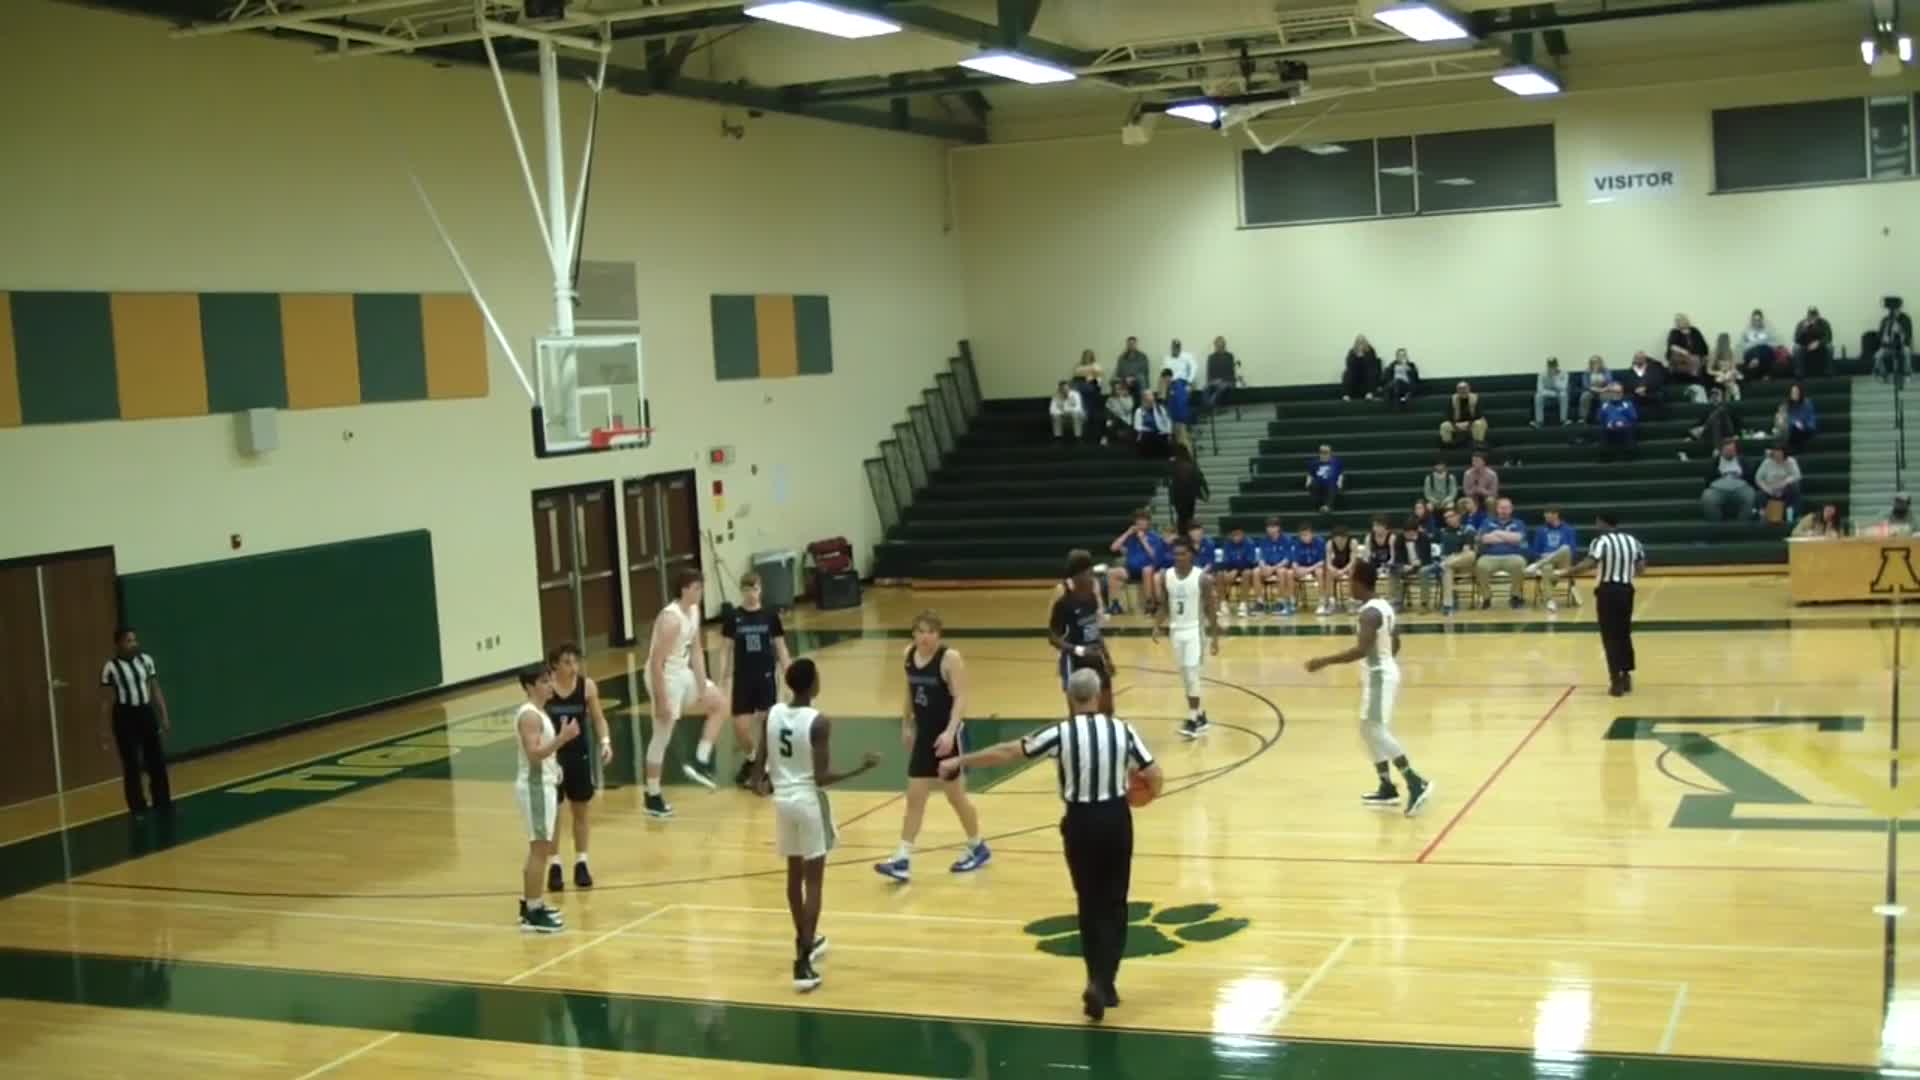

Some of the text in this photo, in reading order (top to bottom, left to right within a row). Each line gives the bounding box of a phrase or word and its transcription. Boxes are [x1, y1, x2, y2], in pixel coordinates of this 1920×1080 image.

[1593, 170, 1674, 191] VISITOR
[1869, 546, 1920, 593] A
[779, 728, 793, 758] 5
